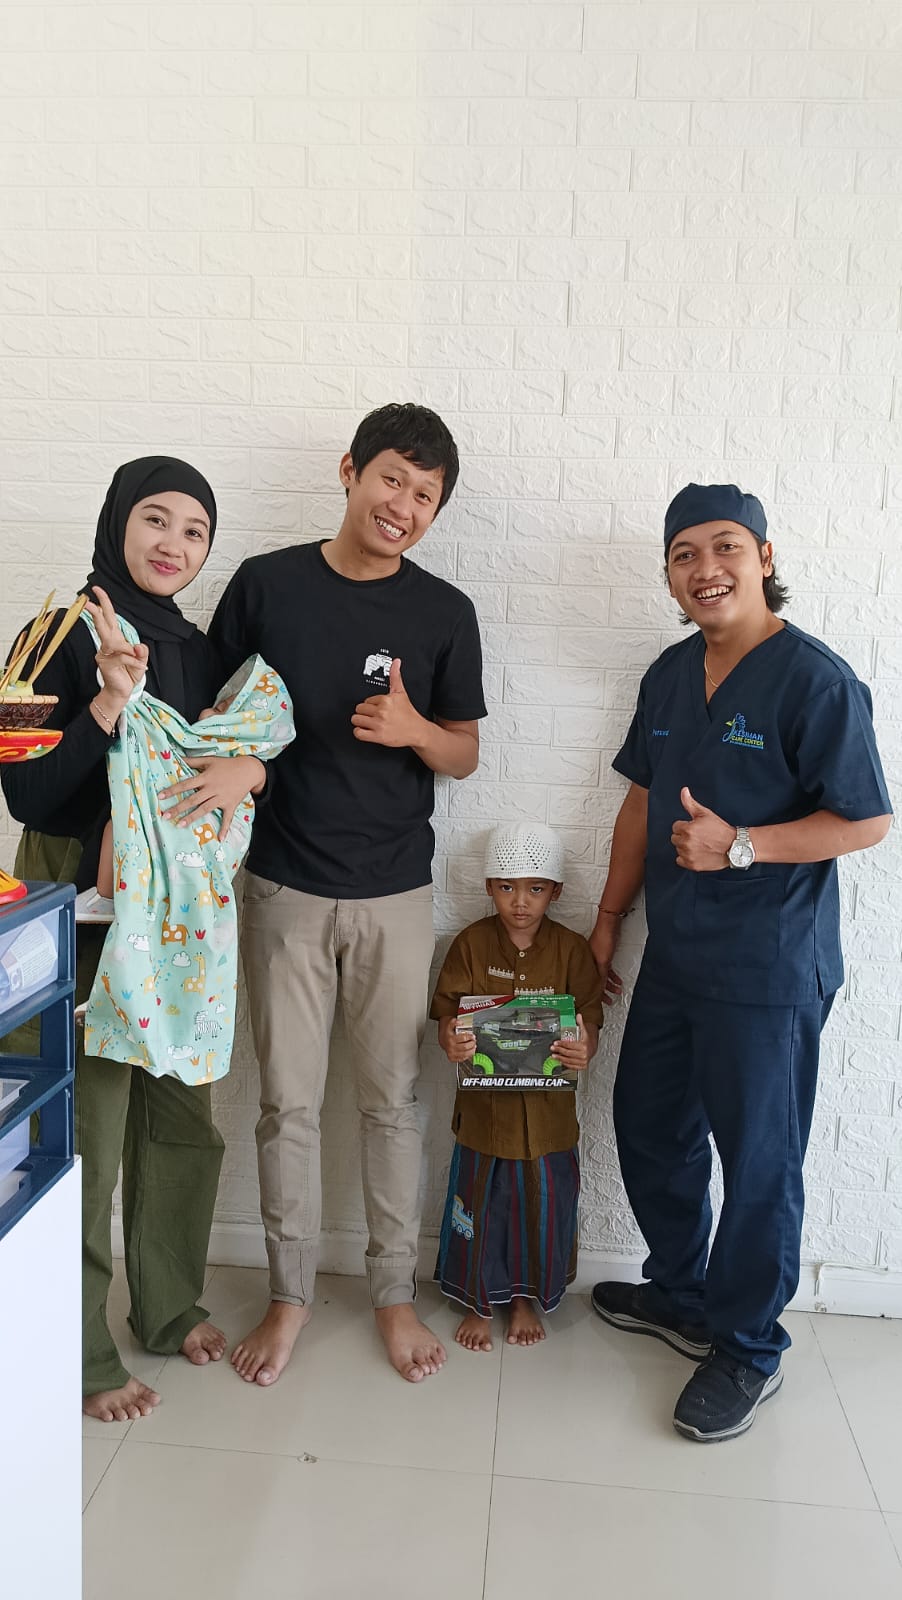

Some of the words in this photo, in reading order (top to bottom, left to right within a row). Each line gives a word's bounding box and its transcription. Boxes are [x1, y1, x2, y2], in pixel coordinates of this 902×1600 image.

[462, 1078, 504, 1087] OFF-ROAD
[504, 1078, 546, 1087] CLIMBING
[545, 1078, 564, 1087] CAR
